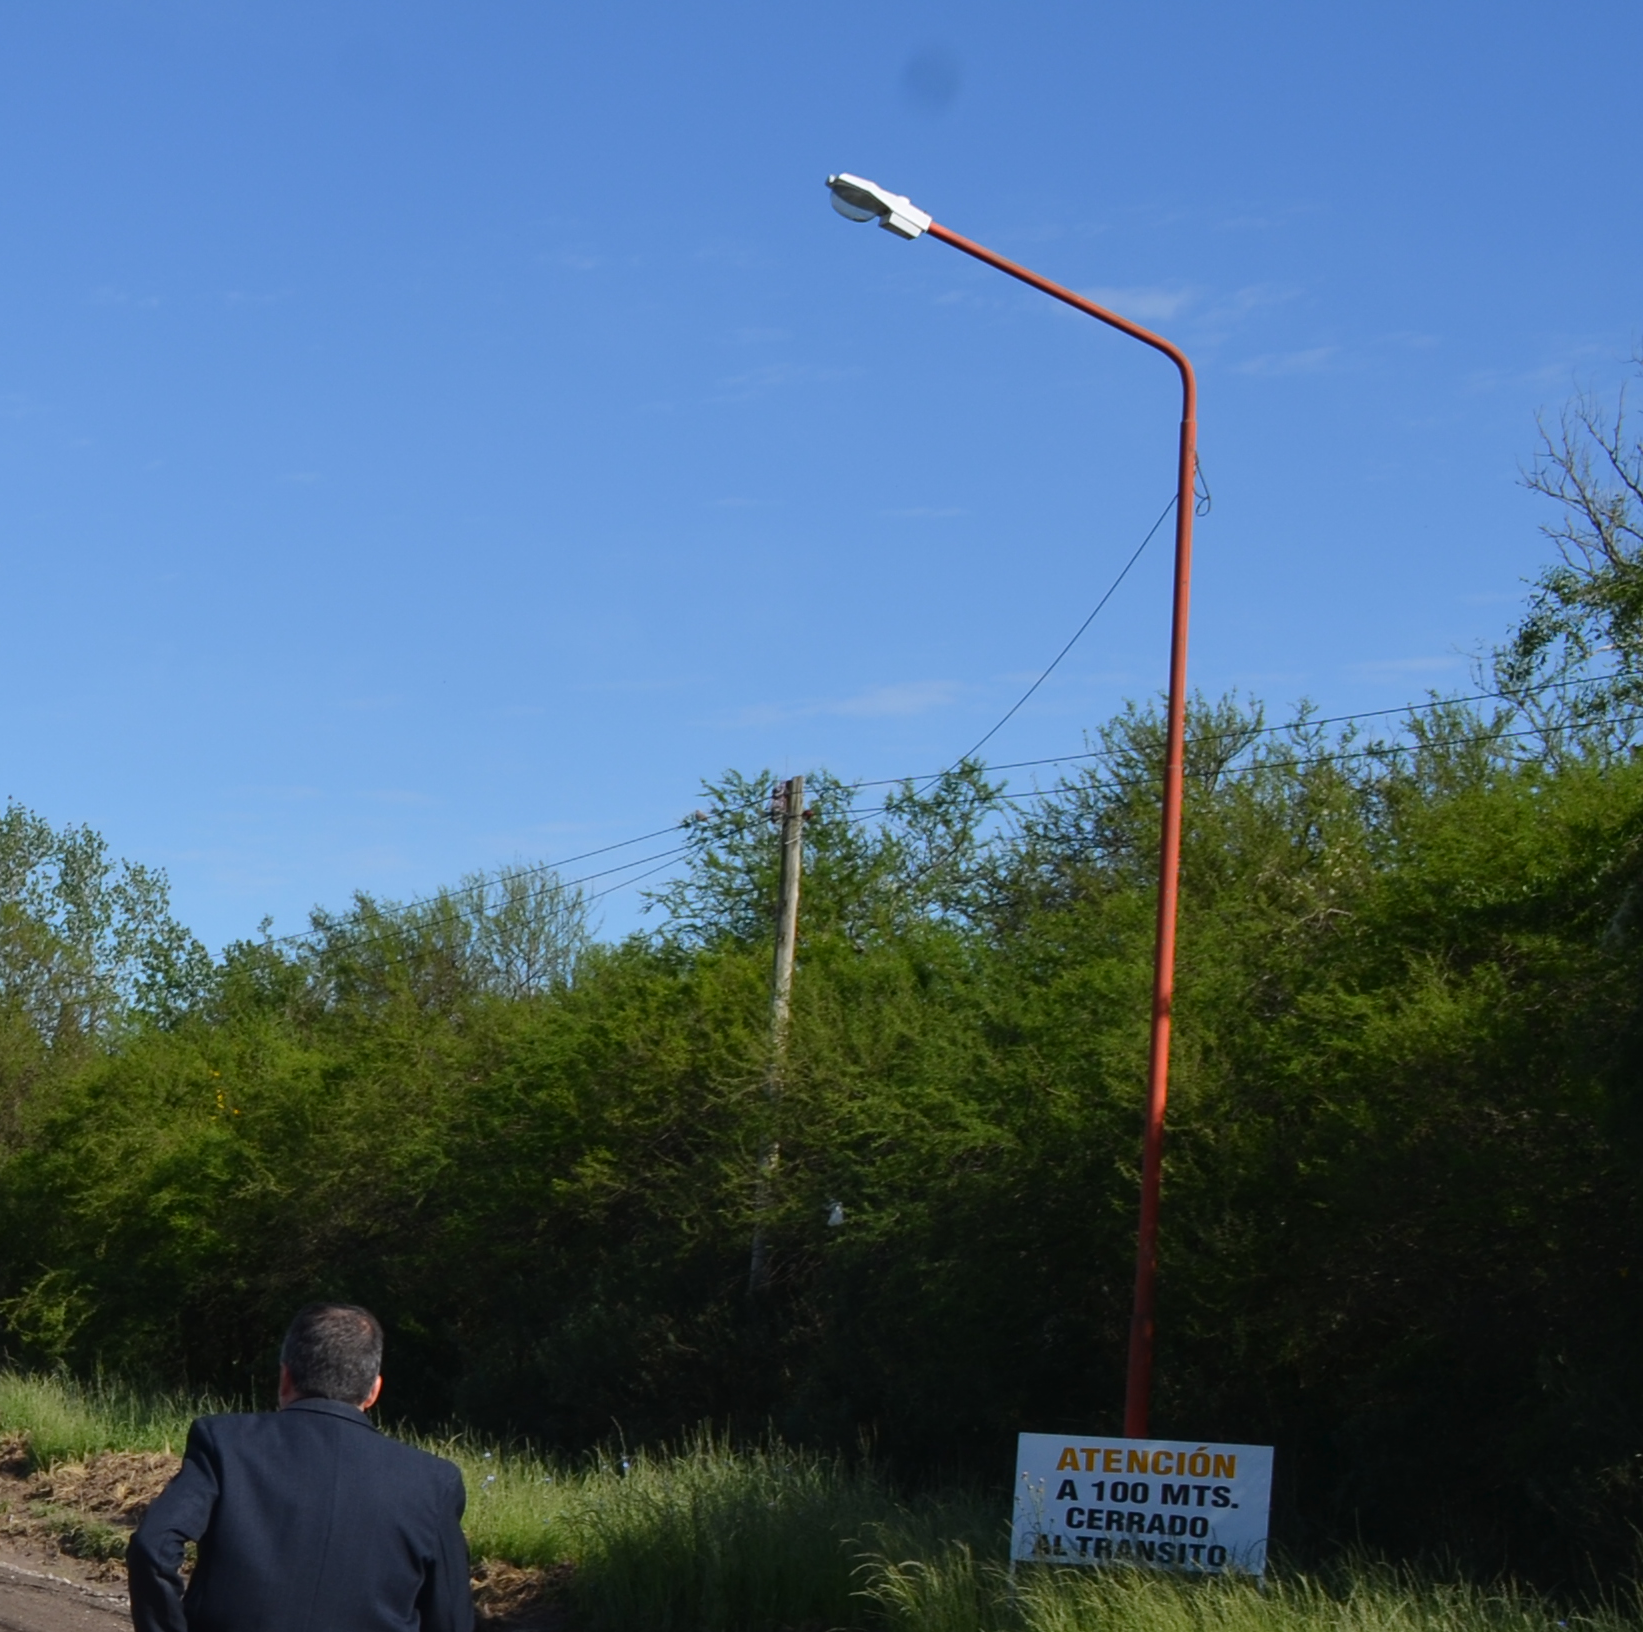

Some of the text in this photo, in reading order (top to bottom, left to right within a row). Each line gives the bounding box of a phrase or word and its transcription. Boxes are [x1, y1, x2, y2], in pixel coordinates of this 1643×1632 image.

[1056, 1445, 1236, 1479] ATENCIÓN
[1056, 1479, 1239, 1509] A 100 MTS.
[1065, 1507, 1209, 1539] CERRADO
[1031, 1534, 1227, 1567] AL TRANSITO
